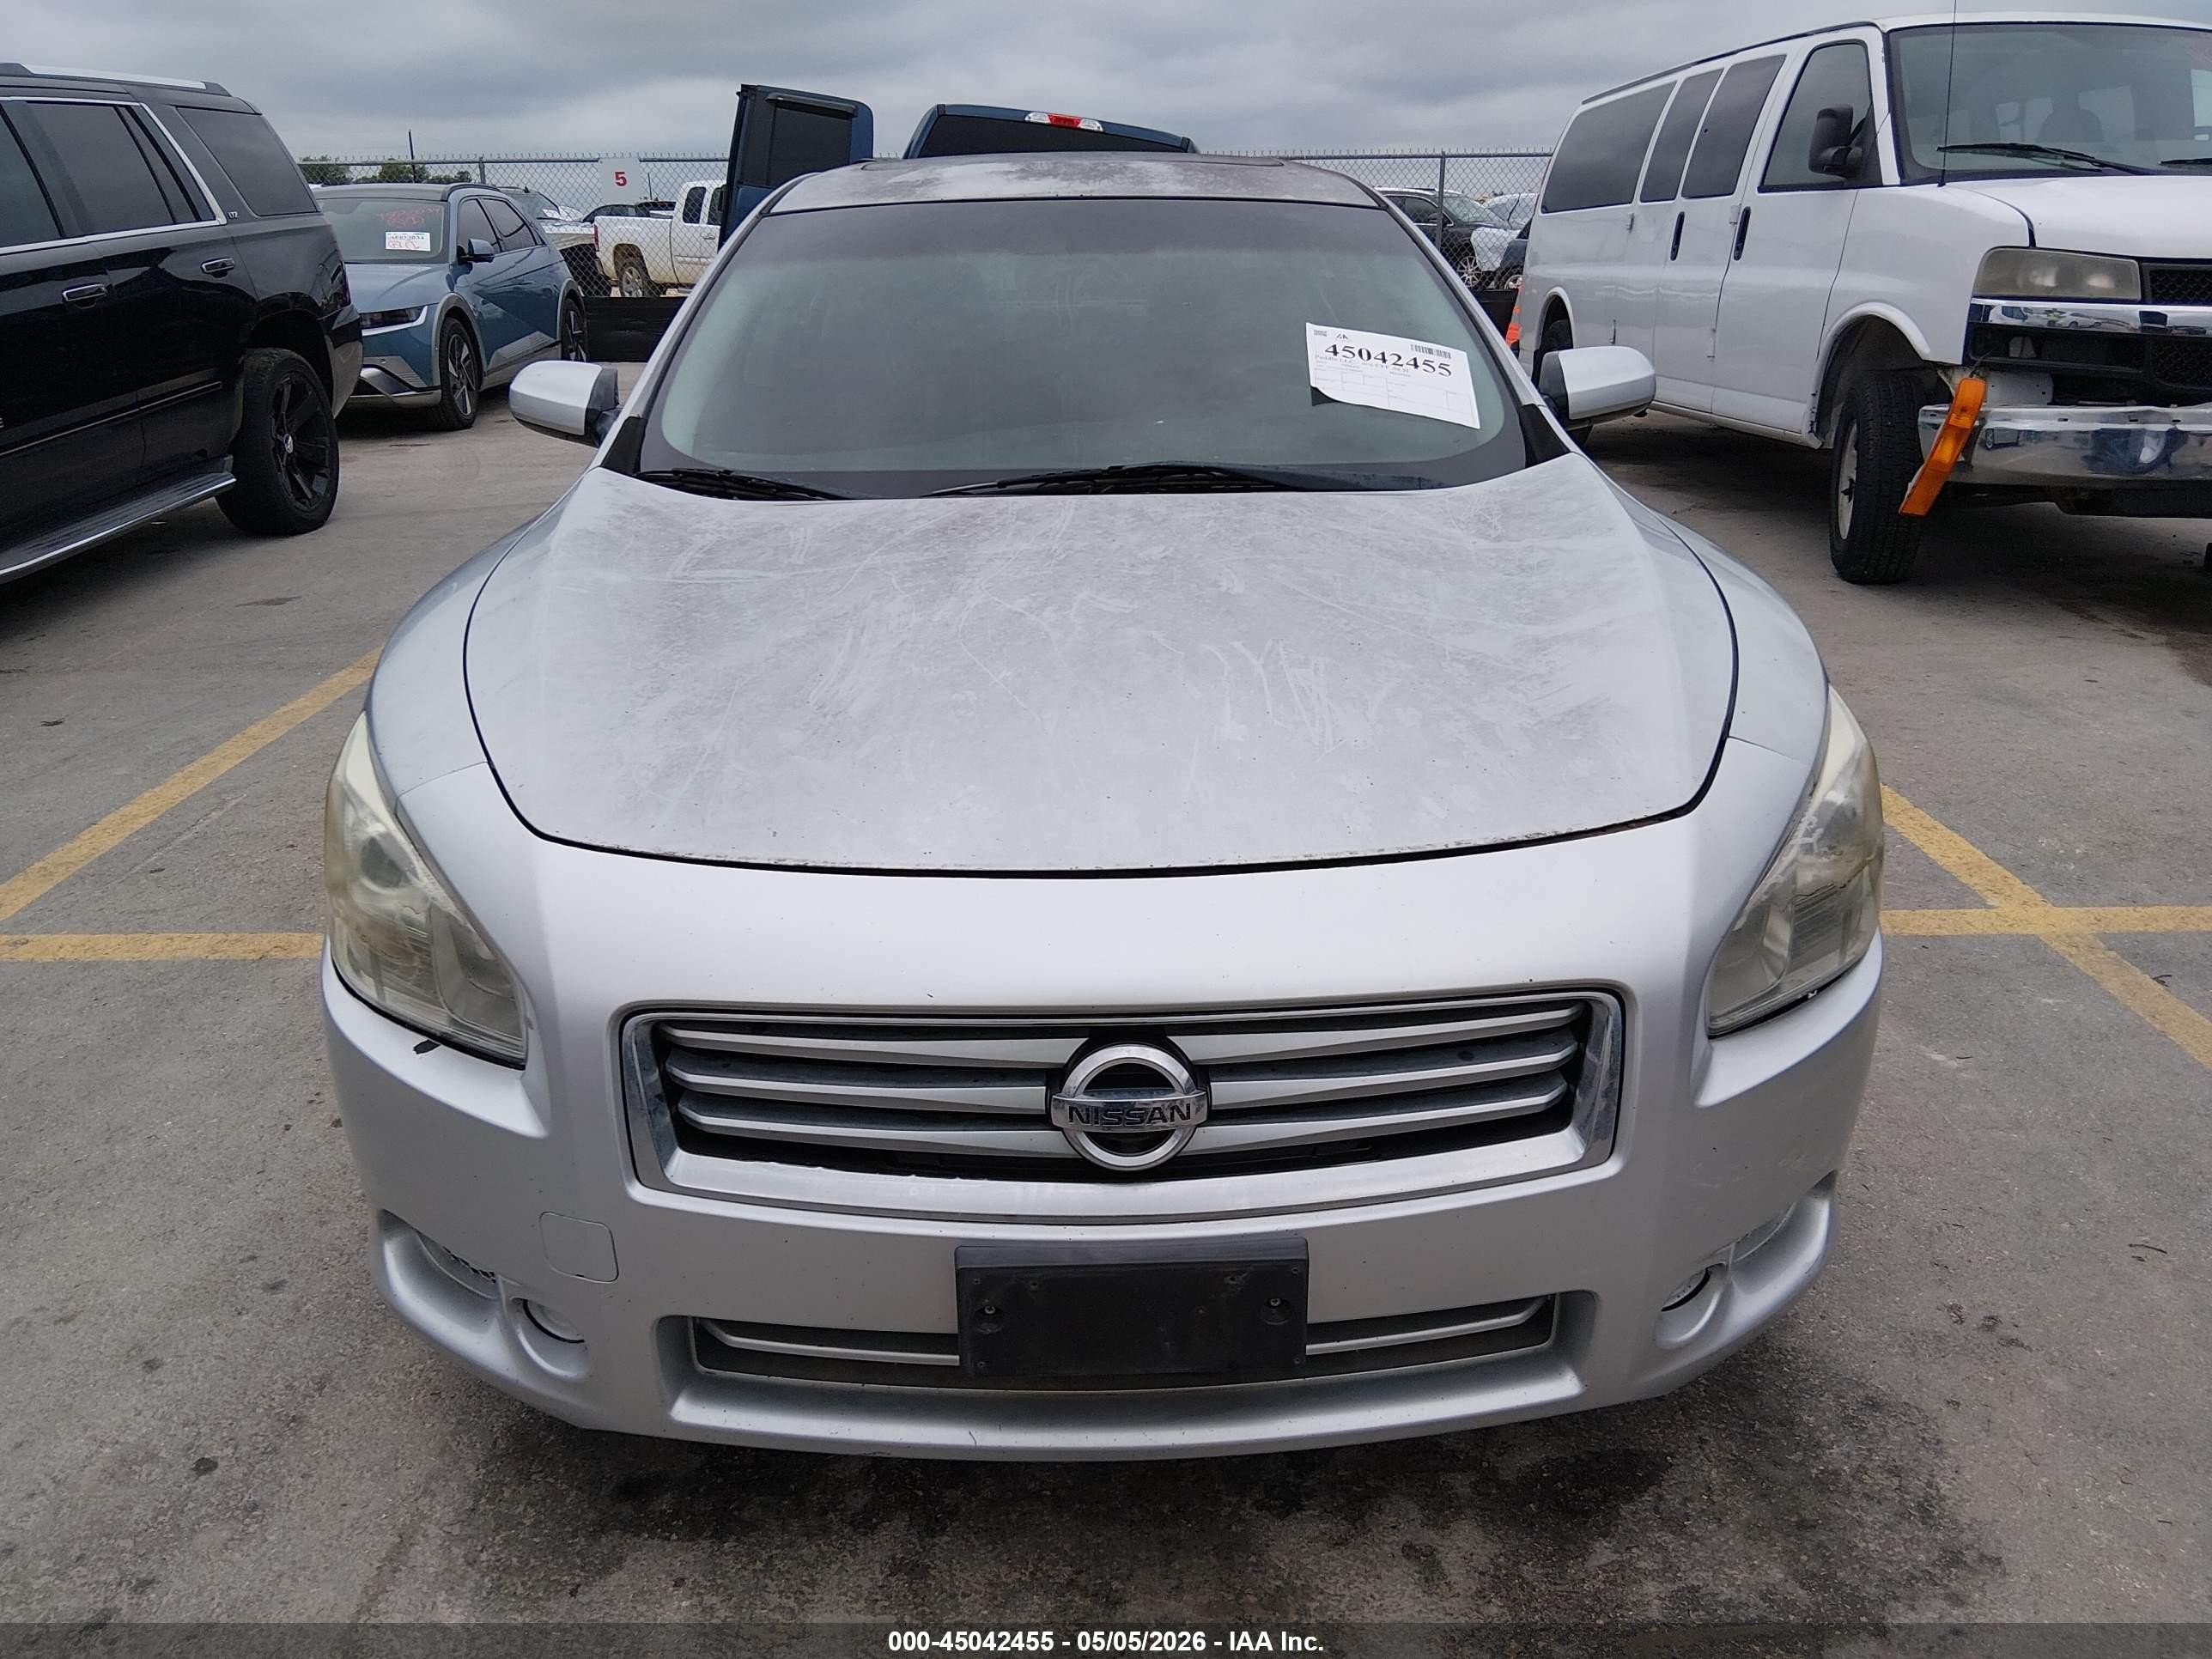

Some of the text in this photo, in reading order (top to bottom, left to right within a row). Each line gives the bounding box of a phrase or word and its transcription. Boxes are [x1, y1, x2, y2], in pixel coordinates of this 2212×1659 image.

[615, 172, 627, 186] 5
[1324, 343, 1452, 377] 45042455
[1068, 1103, 1191, 1126] NISSAN
